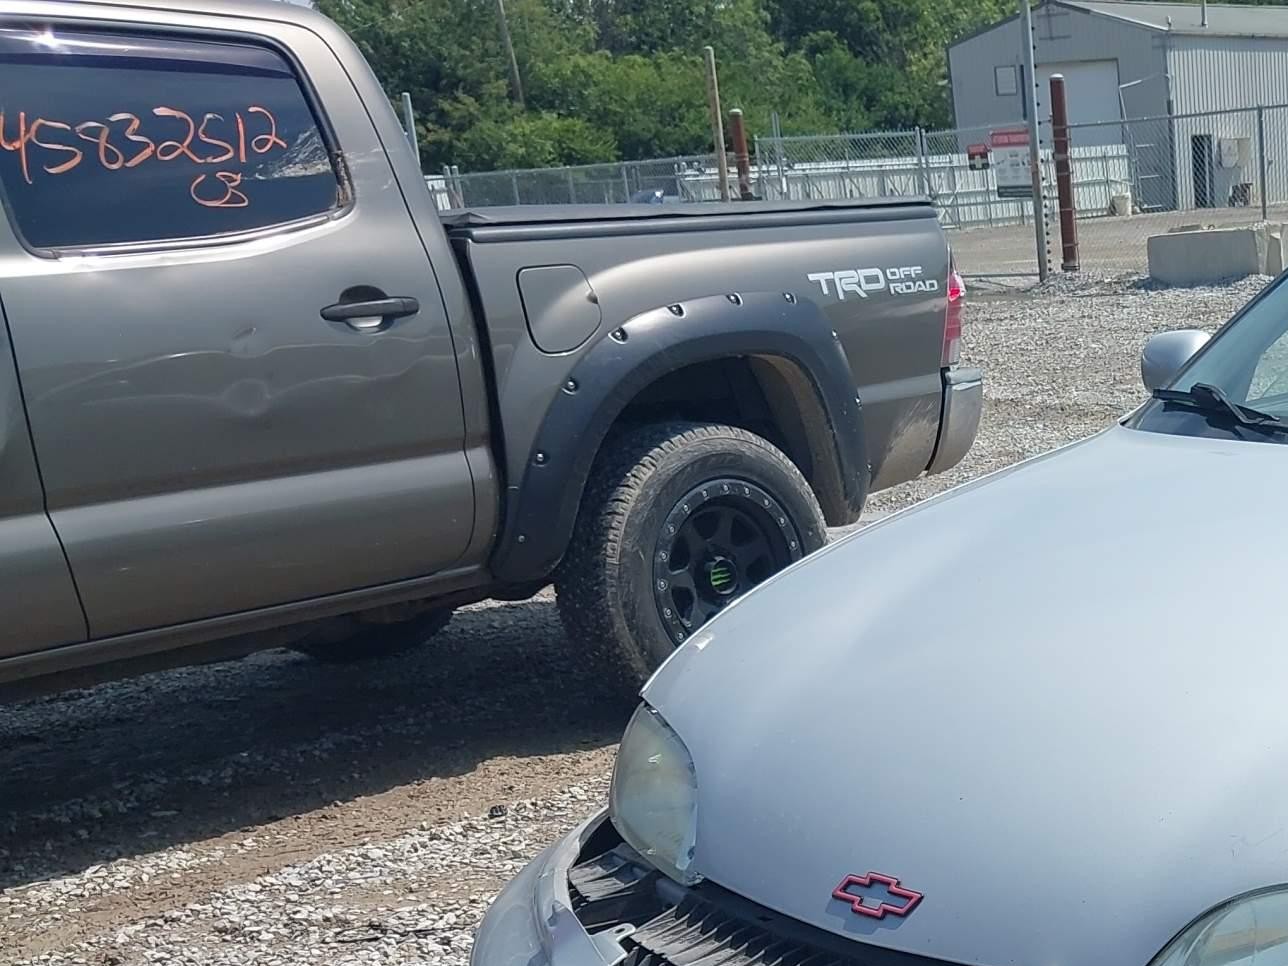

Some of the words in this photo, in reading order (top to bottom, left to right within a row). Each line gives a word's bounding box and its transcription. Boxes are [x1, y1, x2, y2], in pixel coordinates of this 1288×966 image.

[0, 106, 287, 184] 45832512
[807, 267, 886, 300] TRD
[886, 266, 922, 280] OFF
[889, 279, 939, 295] ROAD
